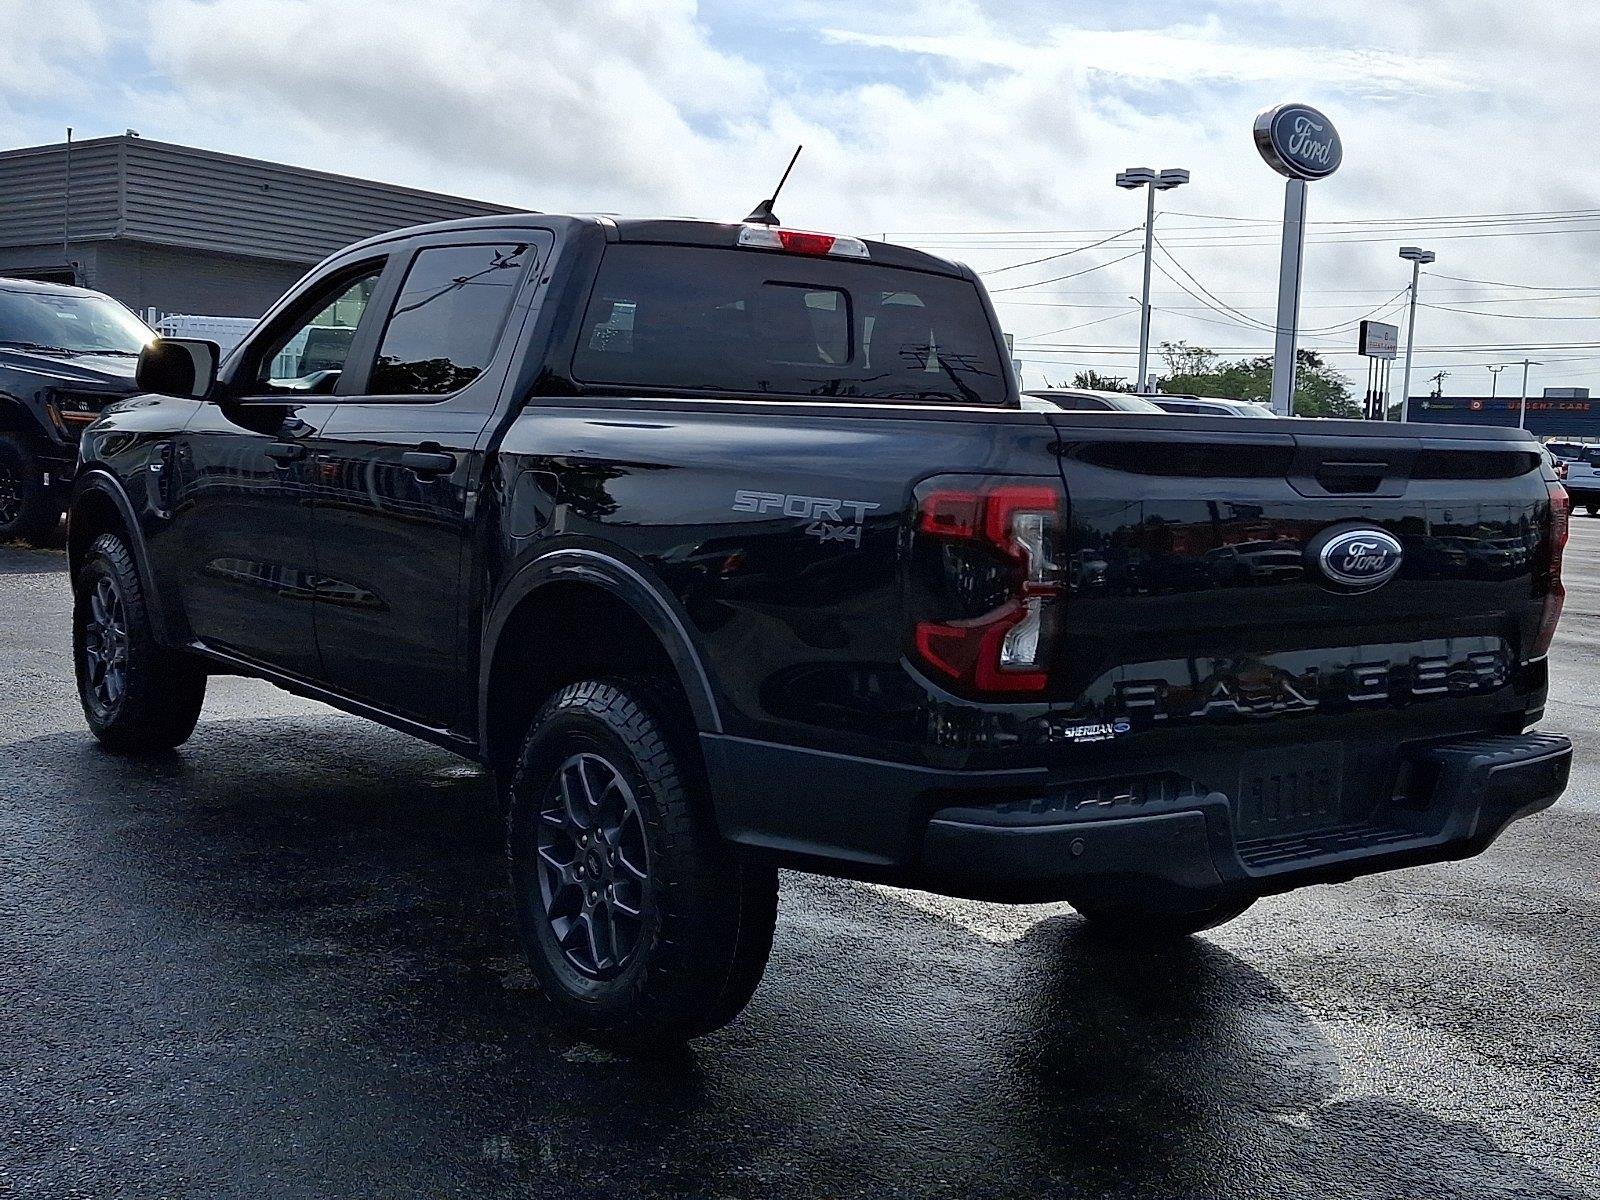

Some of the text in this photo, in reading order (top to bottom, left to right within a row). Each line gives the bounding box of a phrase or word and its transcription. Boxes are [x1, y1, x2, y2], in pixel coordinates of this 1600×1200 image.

[1288, 116, 1334, 165] Ford
[1559, 402, 1591, 410] CARE
[732, 489, 881, 524] SPORT
[1342, 541, 1388, 571] Ford
[1112, 652, 1504, 718] RANGER
[1064, 723, 1114, 738] SHERIDAN
